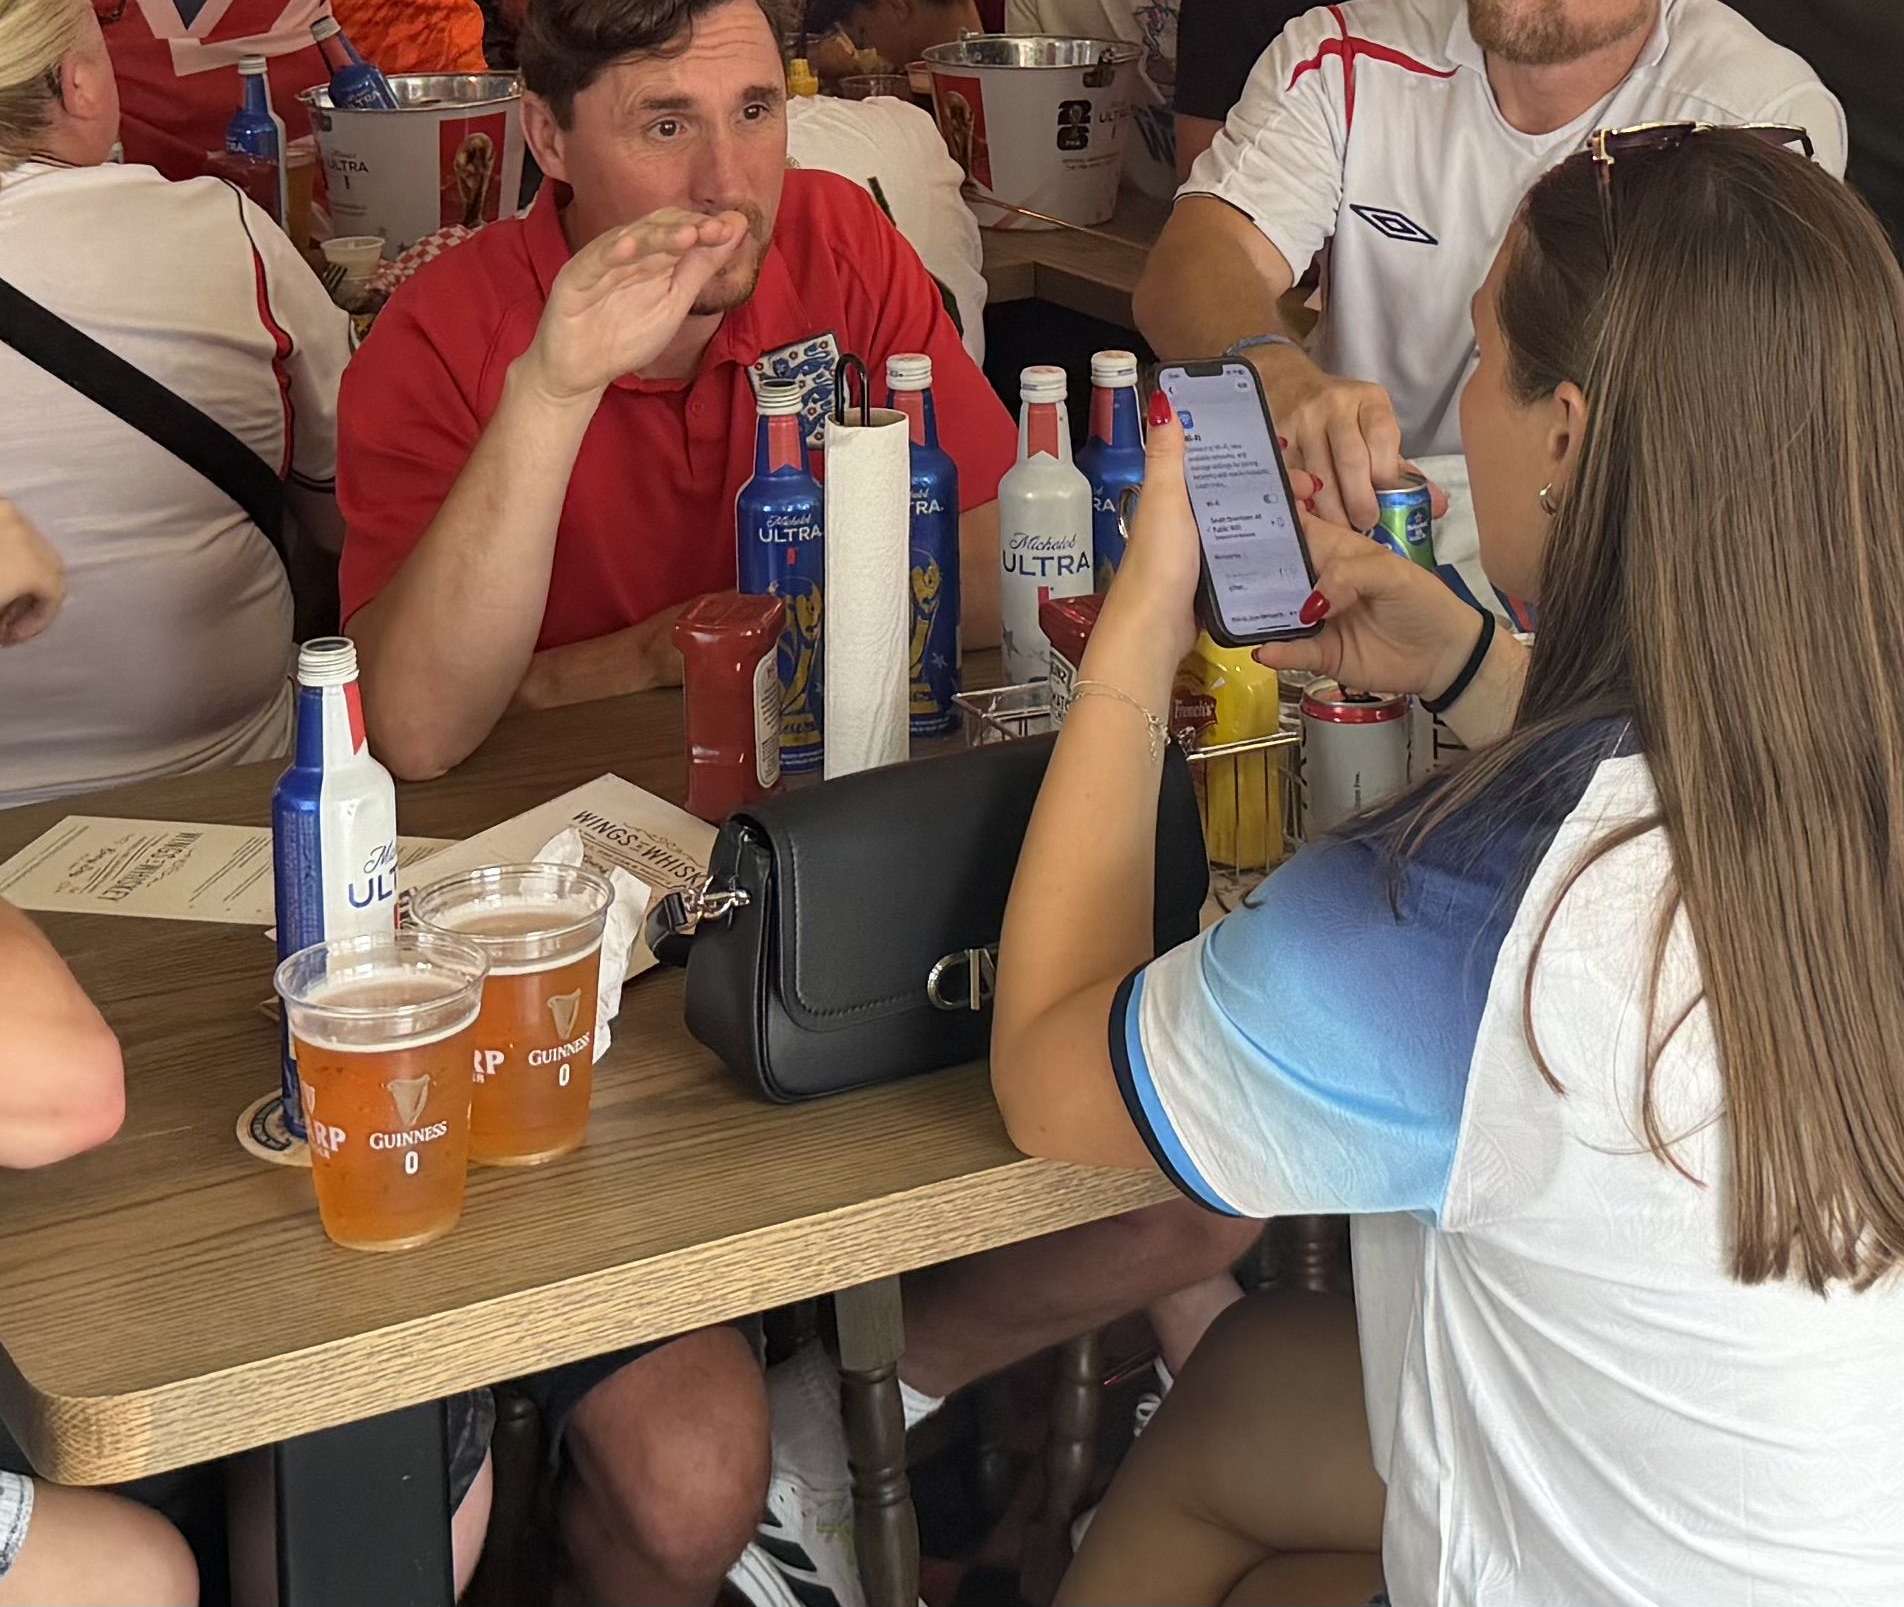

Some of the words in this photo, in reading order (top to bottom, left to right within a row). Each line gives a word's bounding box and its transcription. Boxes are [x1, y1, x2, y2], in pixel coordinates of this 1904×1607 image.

[759, 525, 823, 542] ULTRA
[1003, 549, 1090, 576] ULTRA
[1174, 698, 1214, 719] French's
[572, 810, 639, 847] WINGS
[348, 862, 398, 909] ULT
[528, 1031, 591, 1066] GUINNESS
[558, 1063, 571, 1086] 0
[313, 1120, 347, 1152] RP
[369, 1120, 448, 1150] GUINNESS
[405, 1151, 419, 1174] 0
